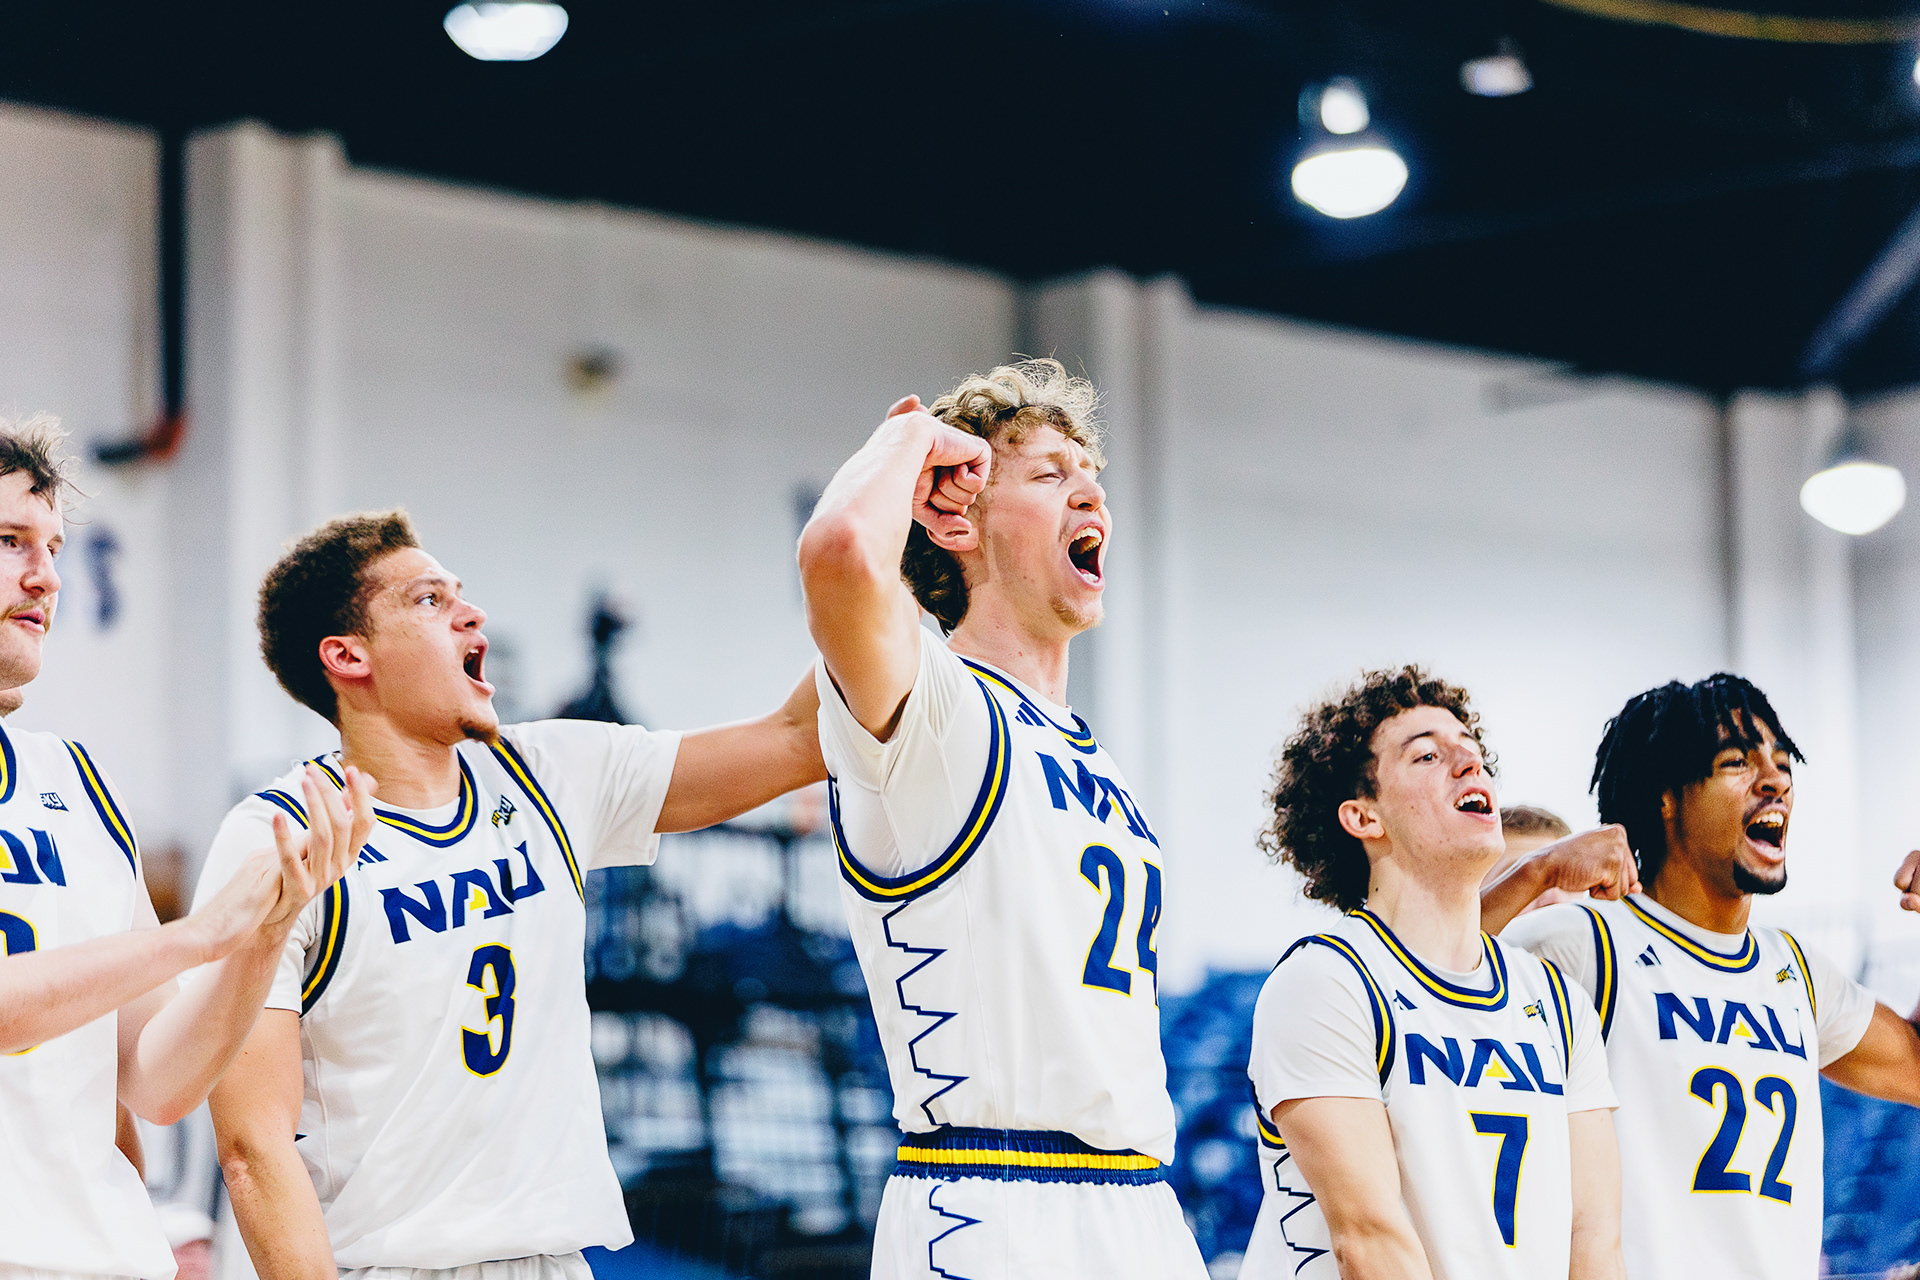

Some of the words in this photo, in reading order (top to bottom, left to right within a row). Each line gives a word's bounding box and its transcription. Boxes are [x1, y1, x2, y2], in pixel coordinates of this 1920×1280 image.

[377, 840, 545, 944] NAU
[1079, 842, 1162, 1009] 24
[461, 942, 517, 1079] 3
[1404, 1032, 1565, 1096] NAU
[1652, 992, 1808, 1061] NAU
[1467, 1110, 1531, 1248] 7
[1688, 1065, 1798, 1207] 22
